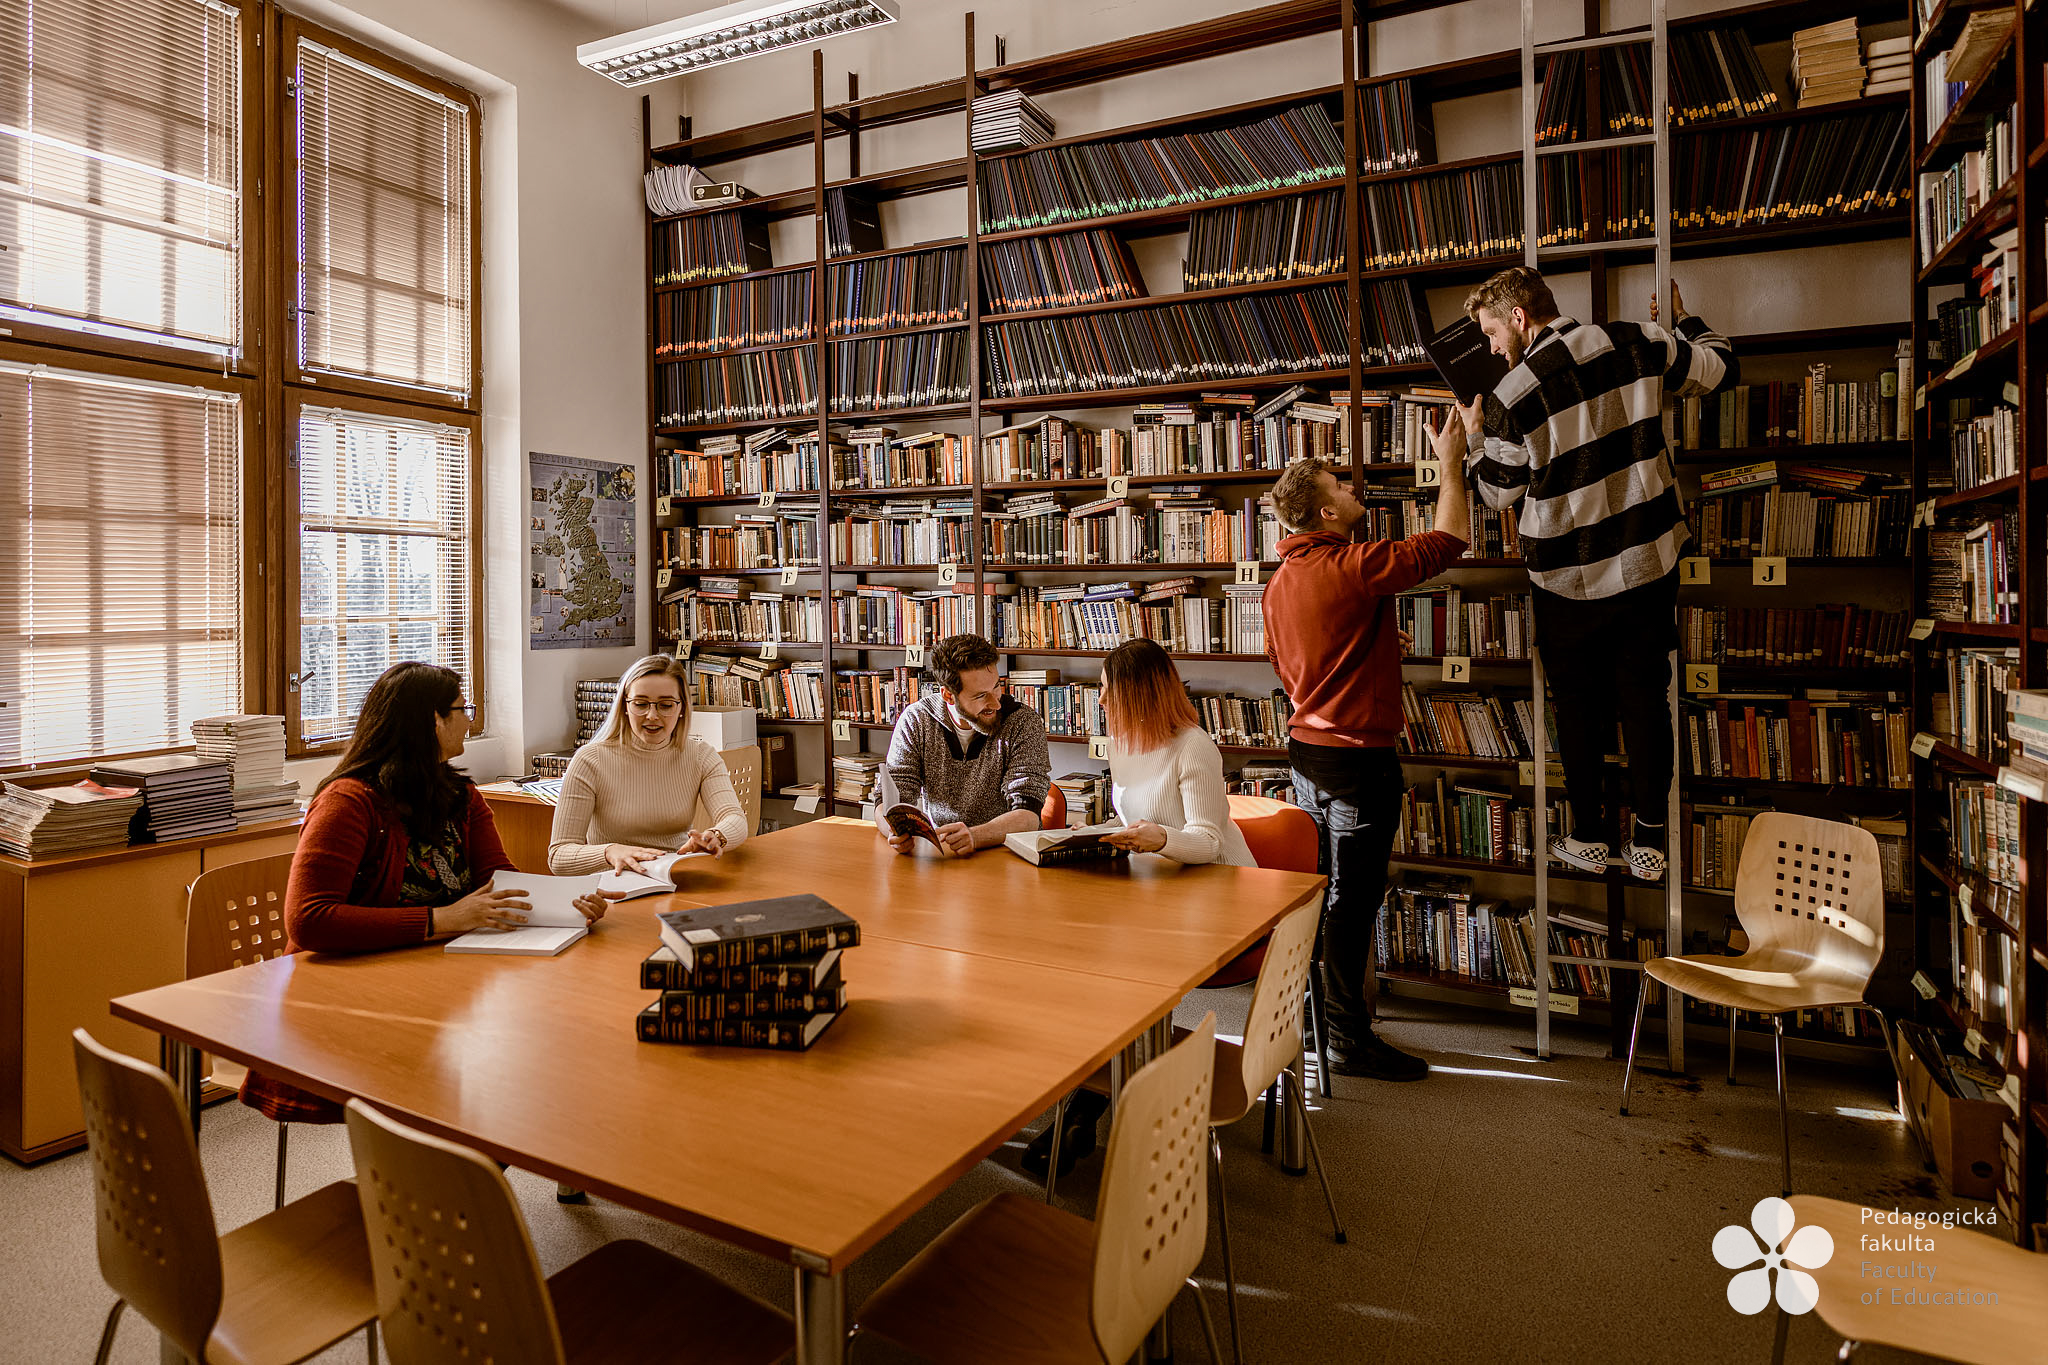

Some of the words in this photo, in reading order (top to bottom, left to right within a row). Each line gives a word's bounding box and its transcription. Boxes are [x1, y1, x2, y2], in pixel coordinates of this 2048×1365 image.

[531, 453, 573, 465] OUTLINE
[577, 459, 613, 471] BRITAIN
[1421, 468, 1436, 484] D
[1111, 480, 1122, 493] C
[659, 502, 668, 513] A
[763, 496, 771, 507] B
[943, 568, 953, 582] G
[1241, 568, 1254, 582] H
[1688, 562, 1697, 578] I
[1762, 565, 1776, 582] J
[660, 573, 668, 585] E
[784, 573, 793, 584] F
[1109, 603, 1117, 618] MOBY
[680, 645, 689, 656] K
[764, 648, 773, 658] L
[908, 650, 920, 662] M
[1450, 664, 1462, 680] P
[1696, 672, 1709, 688] S
[836, 724, 843, 736] T
[1095, 744, 1105, 758] U
[1493, 806, 1502, 856] WHITMAN
